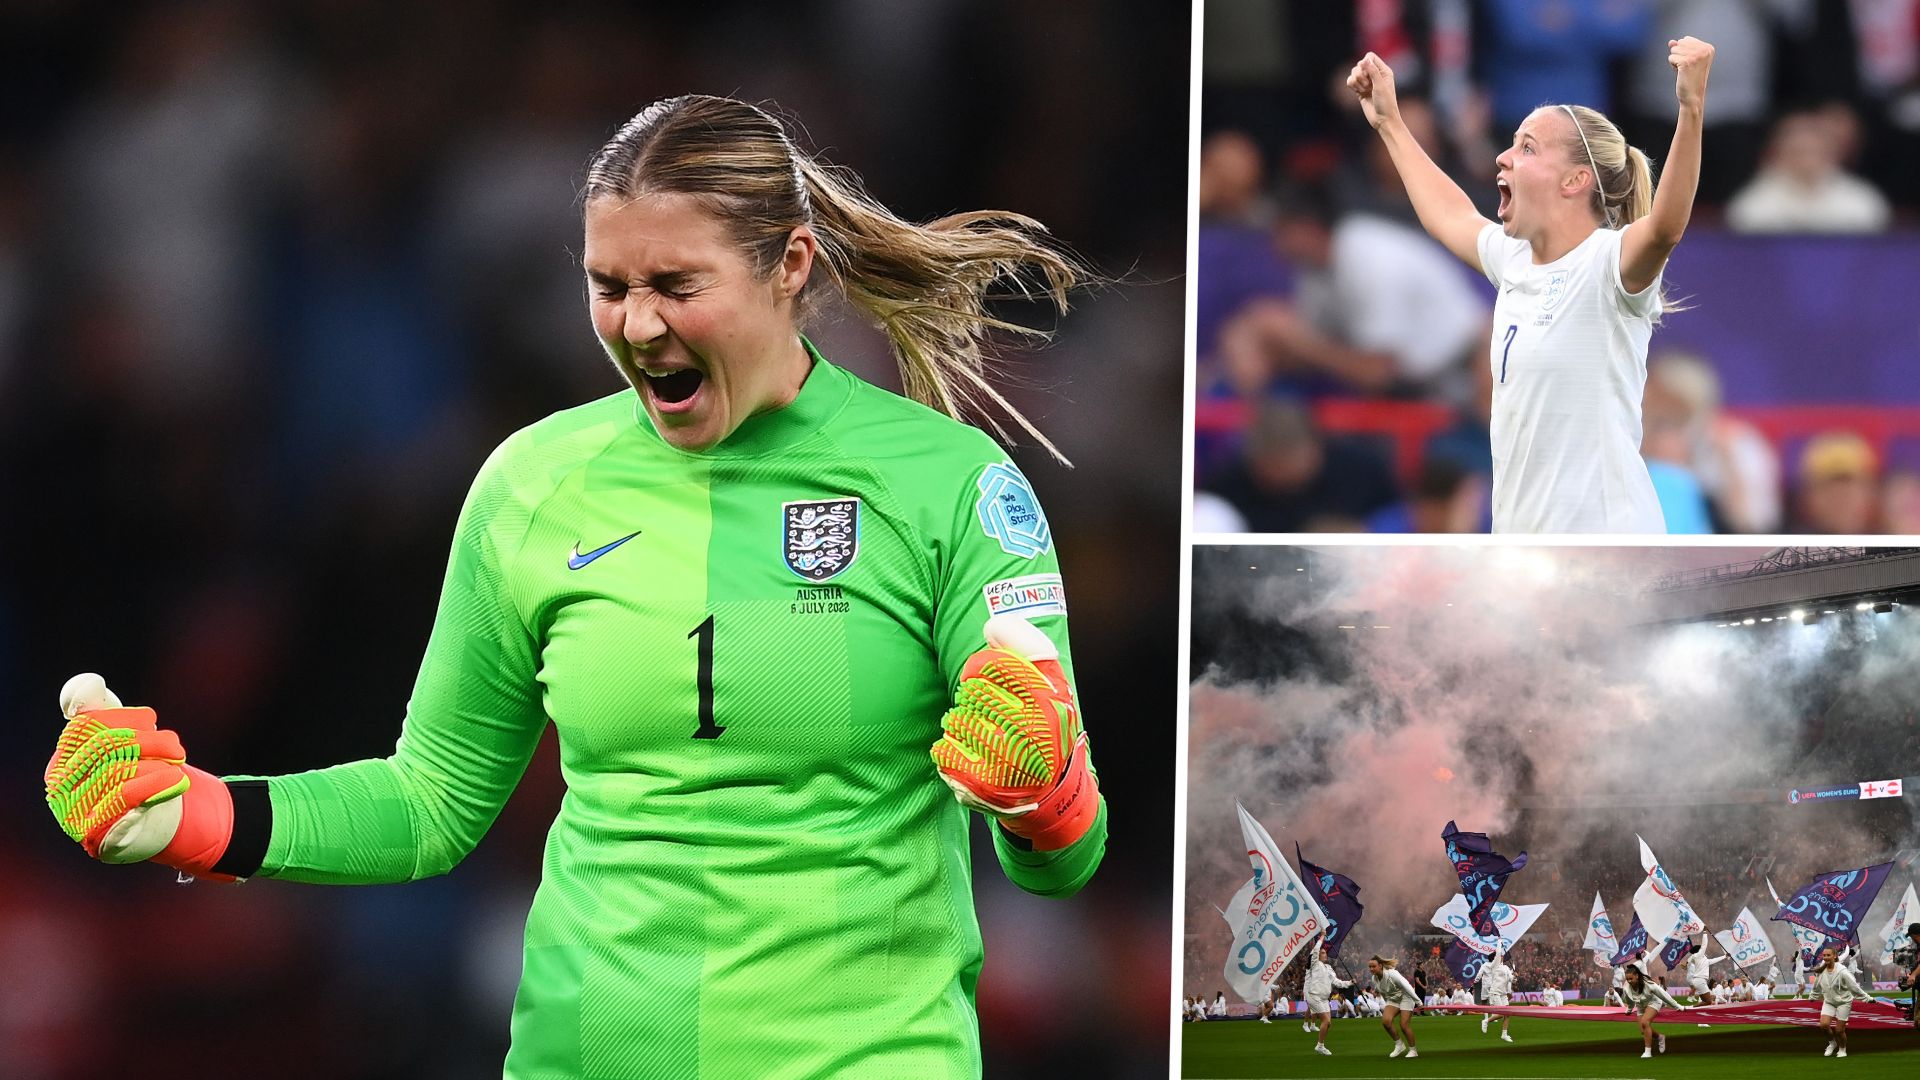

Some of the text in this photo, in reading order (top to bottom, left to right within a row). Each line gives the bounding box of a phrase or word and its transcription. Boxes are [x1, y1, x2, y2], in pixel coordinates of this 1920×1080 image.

[1503, 325, 1517, 383] 7
[1002, 493, 1016, 501] We
[1006, 504, 1026, 514] Play
[1010, 513, 1038, 525] Strong
[796, 587, 843, 600] AUSTRIA
[987, 582, 1013, 595] UEFA
[790, 601, 850, 614] 6 JULY 2022
[688, 614, 727, 739] 1
[1816, 789, 1843, 798] WOMEN'S
[1843, 788, 1859, 796] EURO
